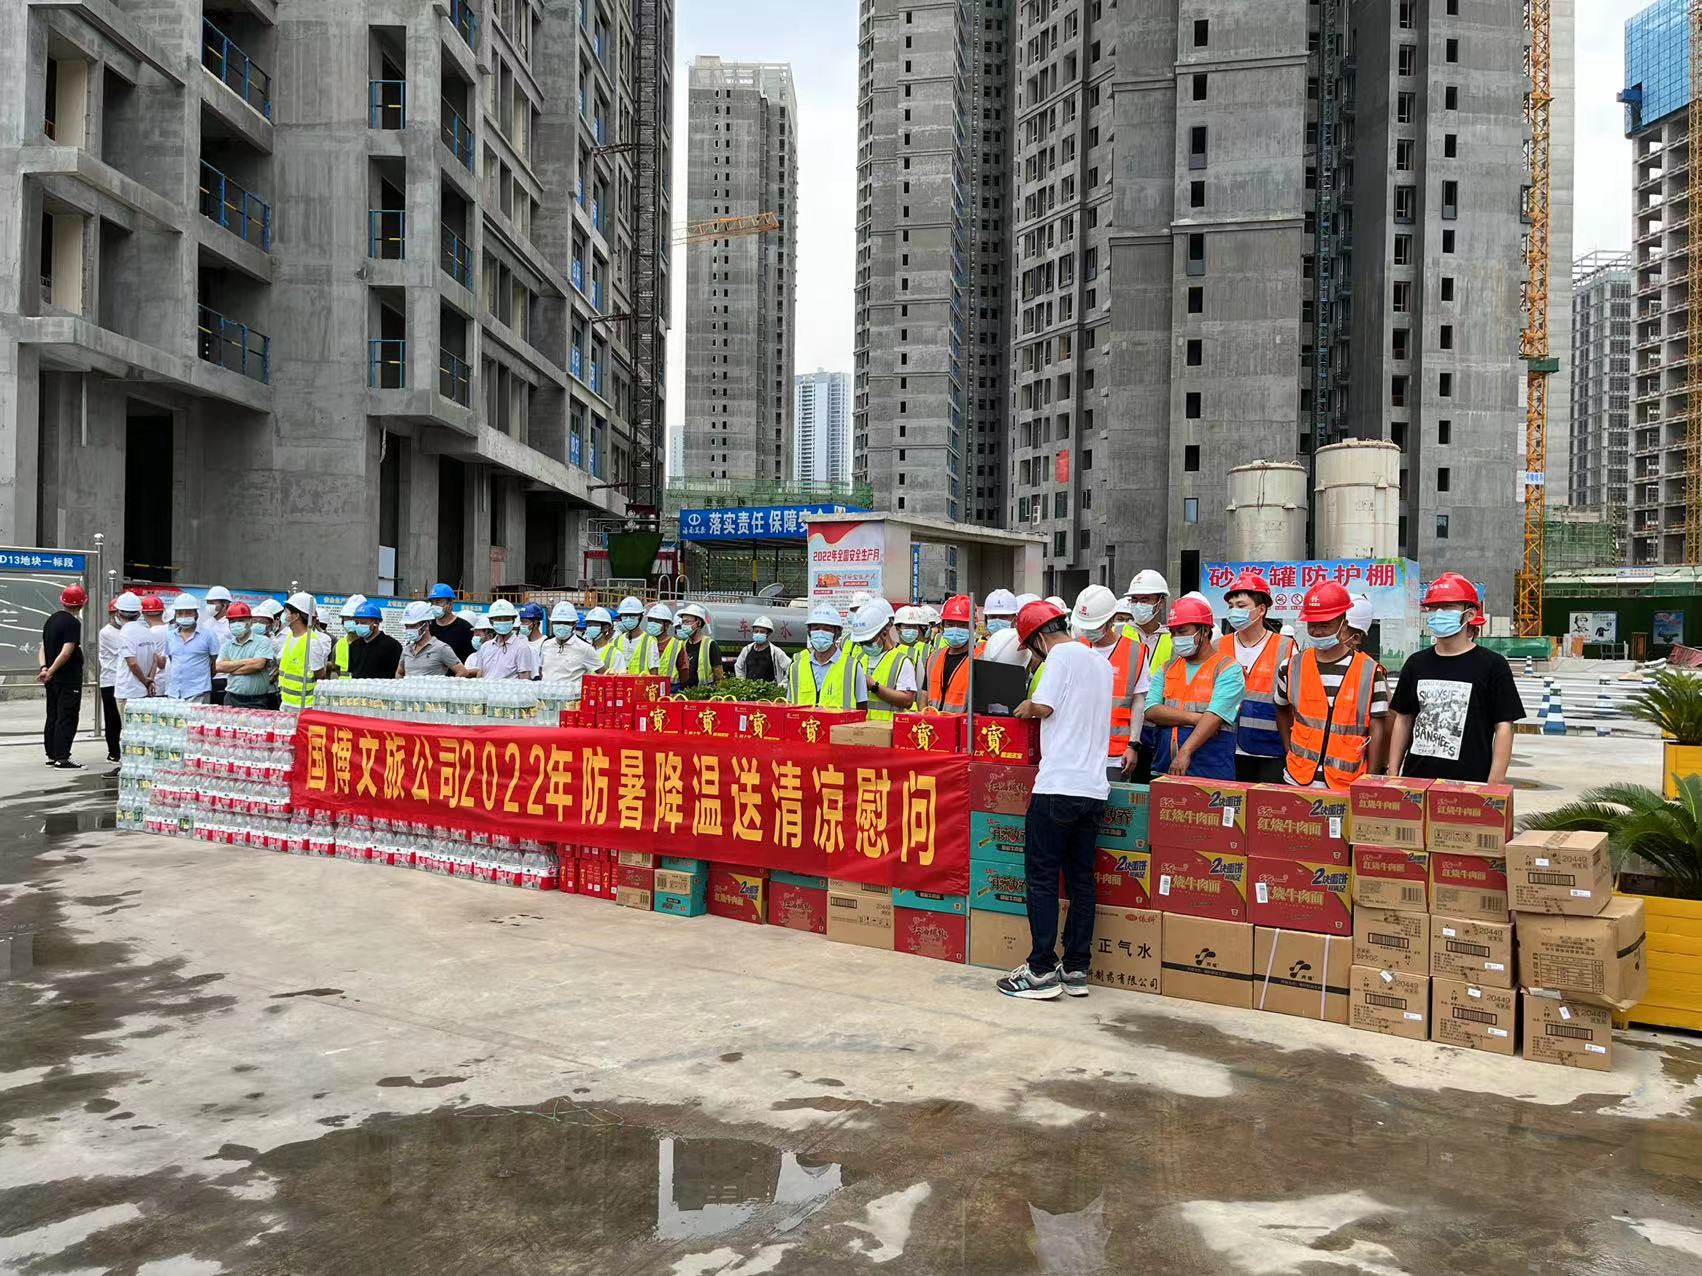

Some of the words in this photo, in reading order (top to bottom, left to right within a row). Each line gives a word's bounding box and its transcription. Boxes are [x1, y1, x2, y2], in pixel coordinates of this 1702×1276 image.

[709, 510, 765, 536] 落实责任
[0, 554, 74, 568] D13地块一标段
[813, 548, 880, 562] 2022年全国安全生产月
[738, 618, 750, 640] 车
[780, 621, 793, 640] 水
[1415, 726, 1456, 757] BANSHEES
[305, 724, 938, 867] 国博文旅公司2022年防暑降温送清凉慰问
[1159, 809, 1220, 826] 红烧牛肉面
[1257, 818, 1323, 837] 红烧牛肉面
[1562, 855, 1588, 863] 20449
[1168, 875, 1222, 894] 烧牛肉面
[1267, 887, 1325, 905] 烧牛肉面
[1098, 937, 1152, 960] 正气水
[1396, 979, 1419, 989] 20449
[1486, 994, 1511, 1004] 20449
[1580, 1008, 1607, 1018] 20449
